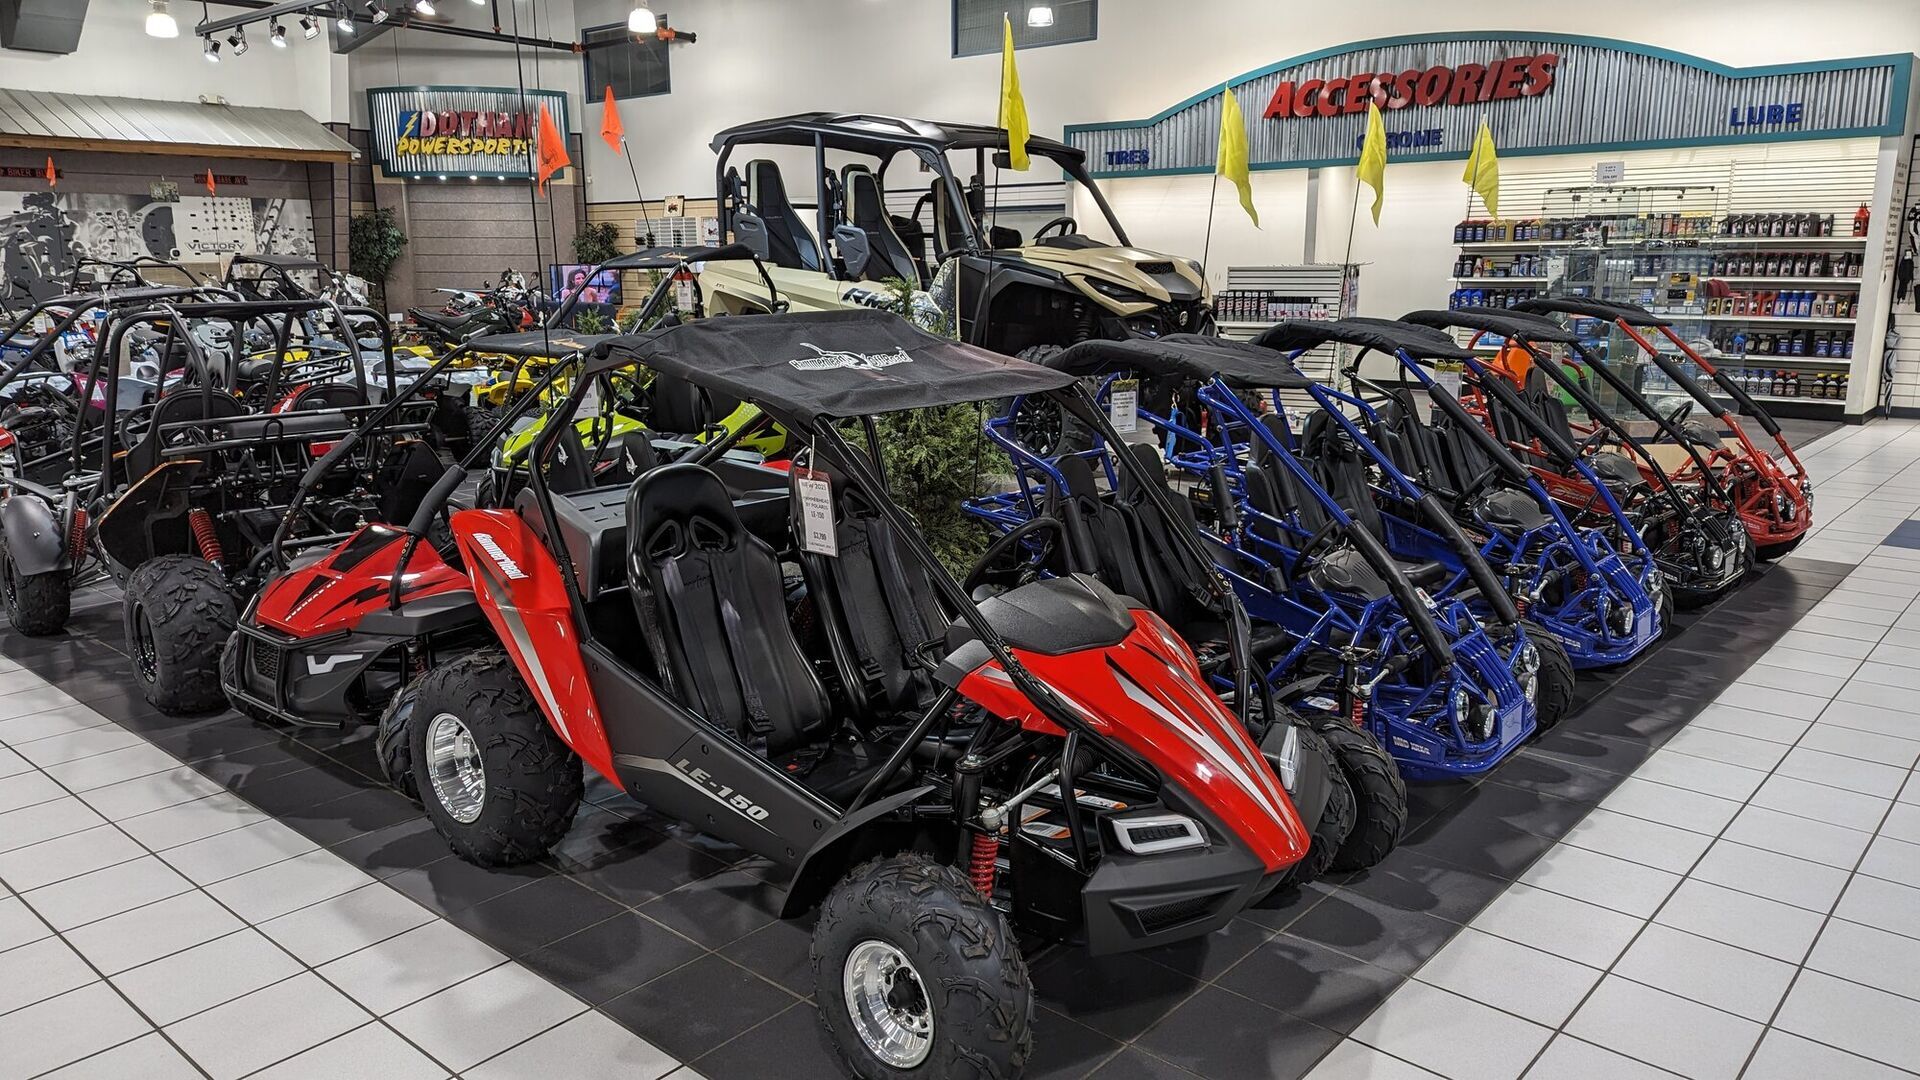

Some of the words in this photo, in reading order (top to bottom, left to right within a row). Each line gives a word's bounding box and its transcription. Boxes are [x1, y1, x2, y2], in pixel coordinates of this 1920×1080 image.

[1263, 52, 1559, 119] ACCESSORIES
[420, 110, 534, 138] DOTHAN
[1730, 103, 1803, 127] LUBE
[397, 137, 533, 157] POWERSPORTS
[1356, 128, 1444, 152] CROME
[1105, 149, 1150, 165] TIRES
[675, 758, 770, 821] LE-150
